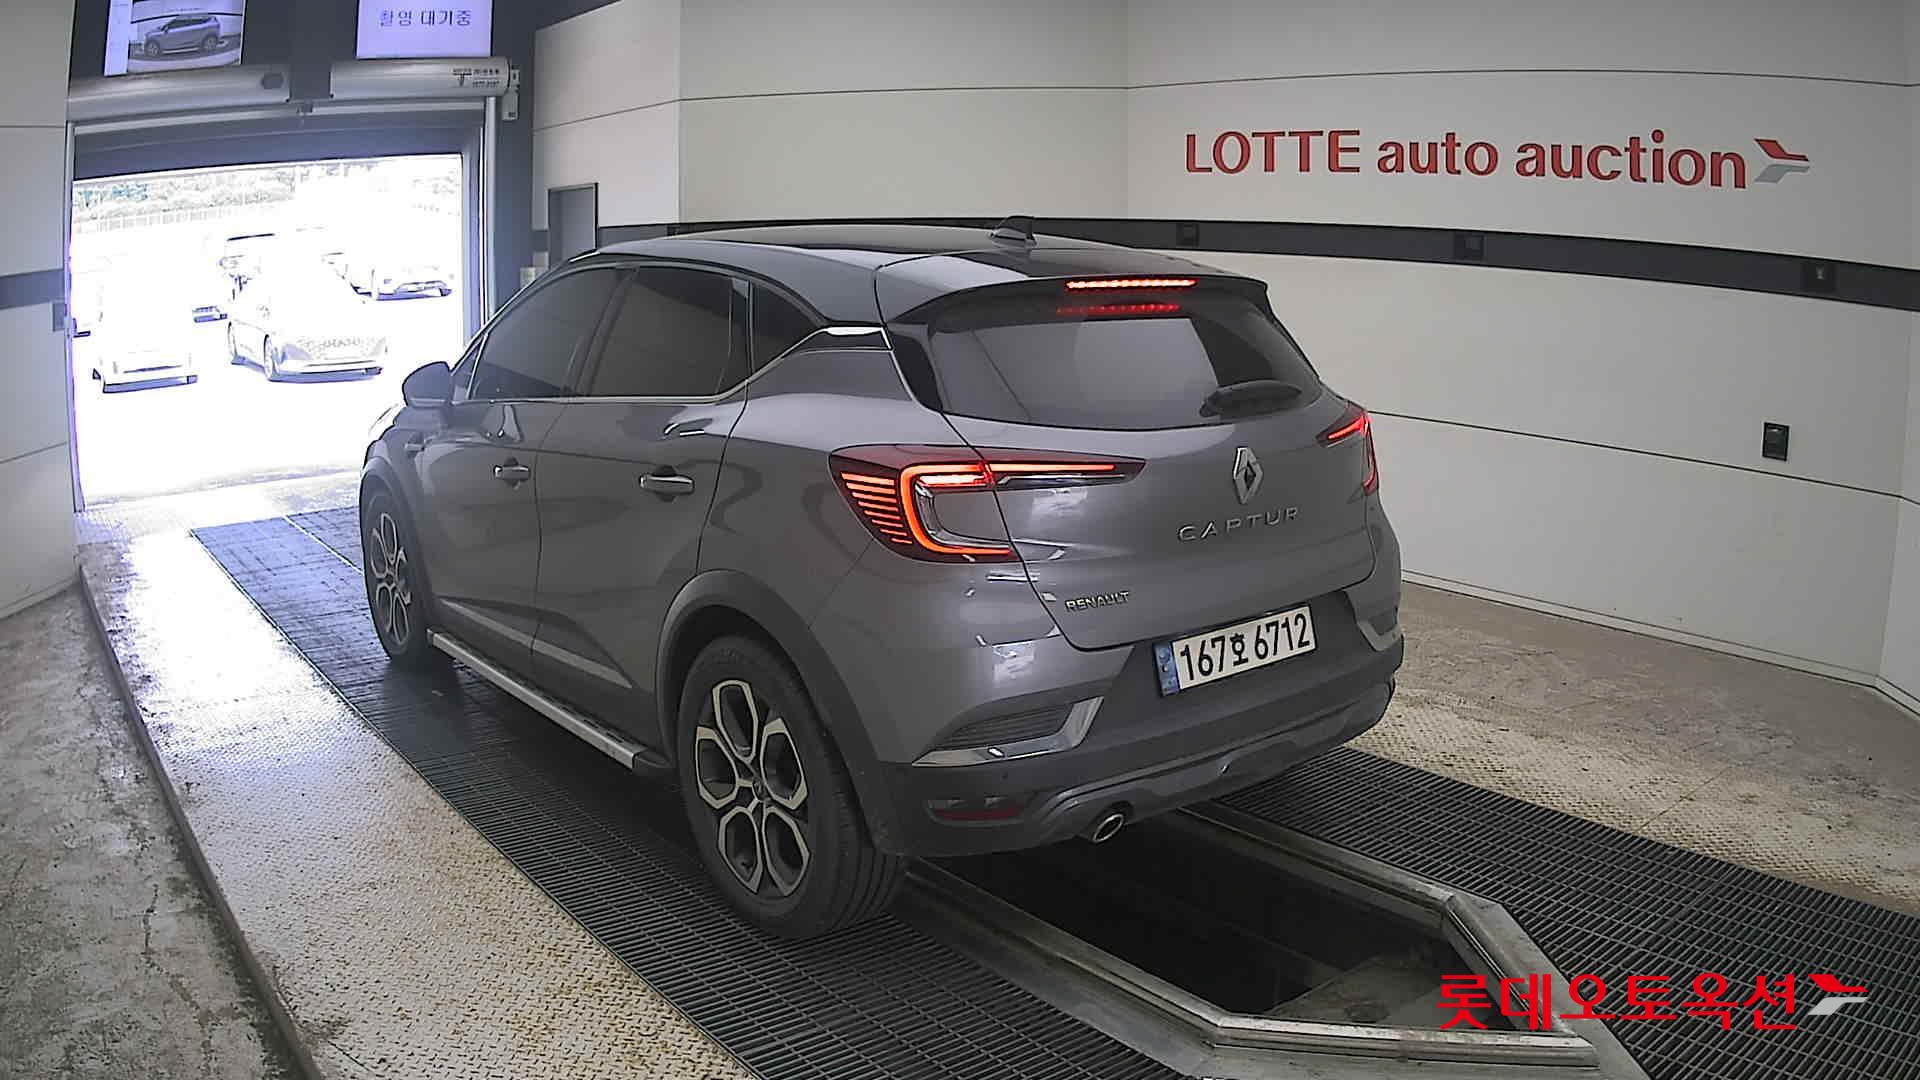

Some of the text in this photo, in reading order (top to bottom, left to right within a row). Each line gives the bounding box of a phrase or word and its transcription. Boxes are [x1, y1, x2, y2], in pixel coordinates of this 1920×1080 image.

[420, 10, 472, 27] 대기중
[1186, 129, 1747, 189] LOTTE auto auction
[1177, 506, 1299, 541] CAPTUR
[1065, 590, 1129, 612] RENAULT
